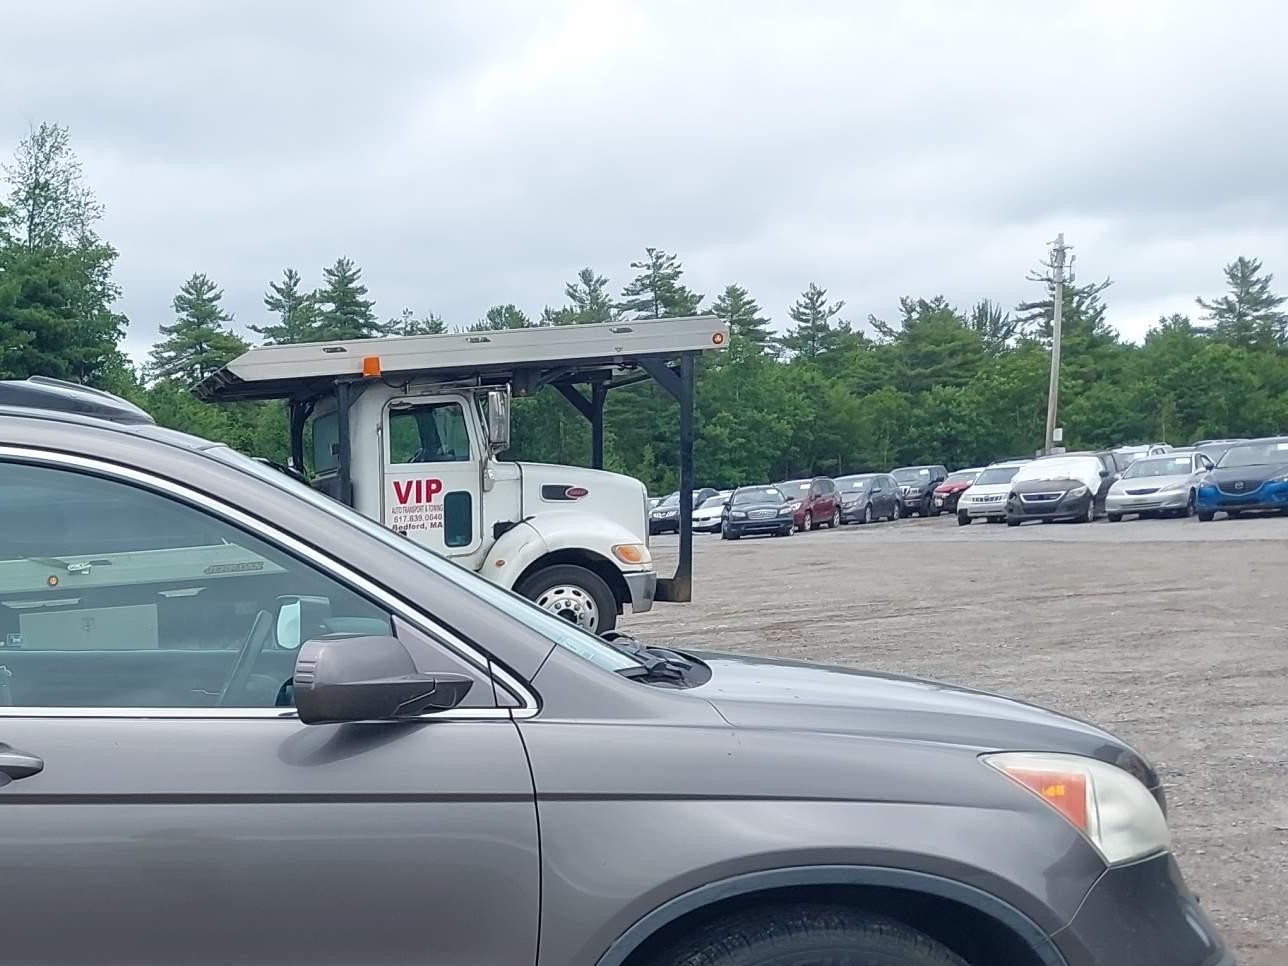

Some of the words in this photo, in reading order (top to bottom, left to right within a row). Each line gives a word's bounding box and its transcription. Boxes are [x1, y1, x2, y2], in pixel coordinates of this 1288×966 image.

[393, 479, 443, 504] VIP
[392, 506, 402, 514] AUTO
[403, 505, 424, 514] TRANSPORT
[392, 522, 428, 531] Bedford,
[430, 521, 443, 529] MA
